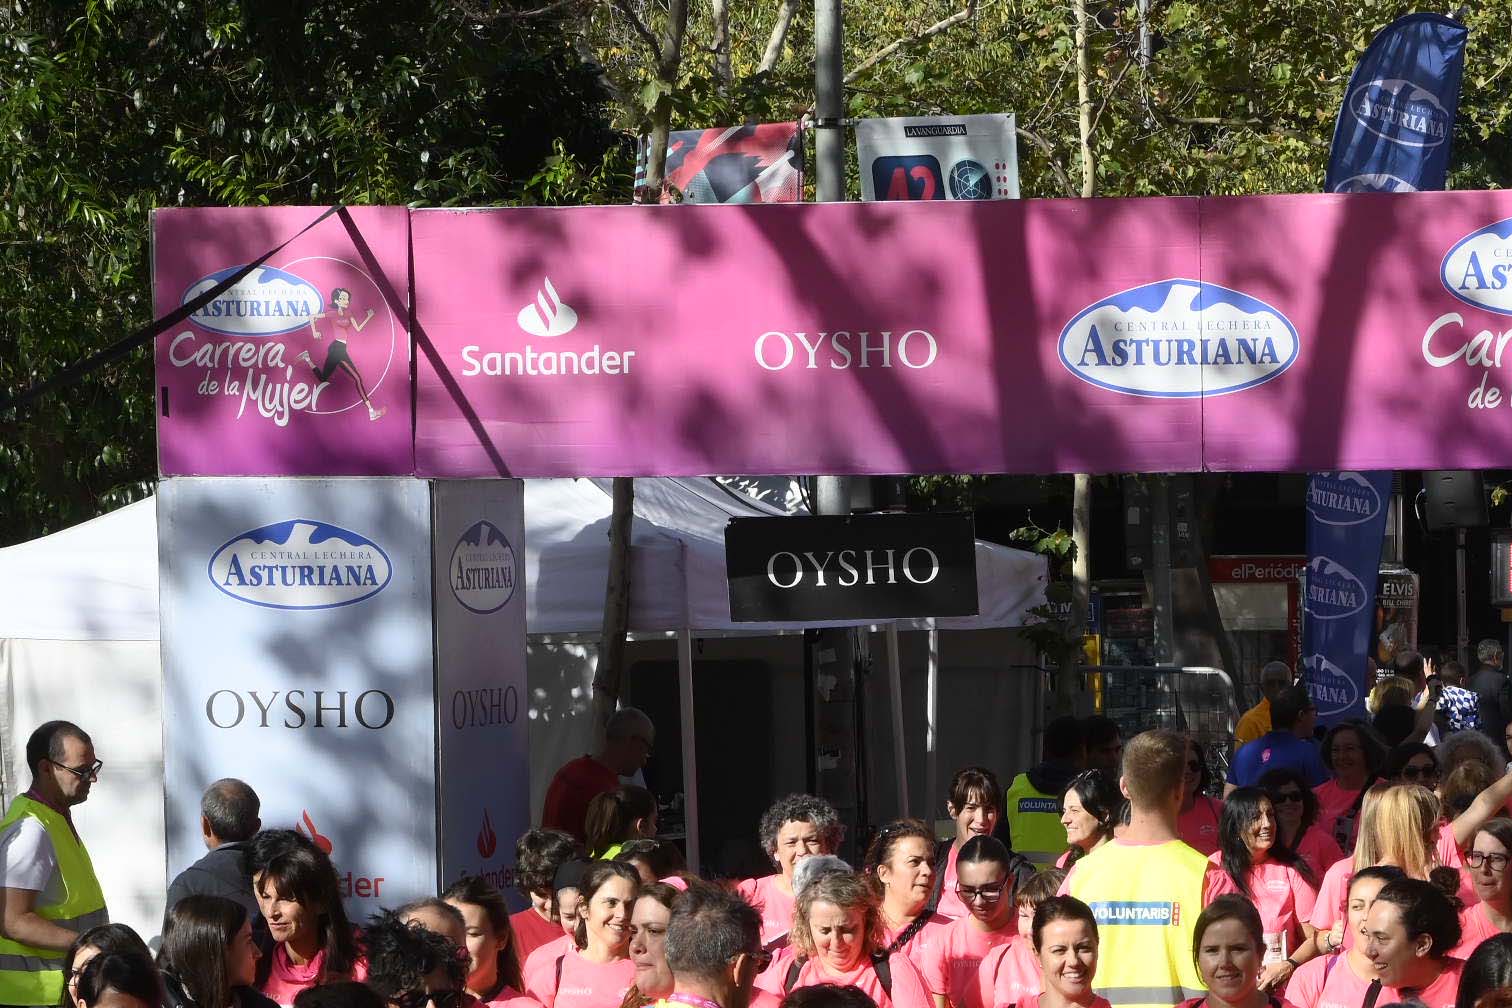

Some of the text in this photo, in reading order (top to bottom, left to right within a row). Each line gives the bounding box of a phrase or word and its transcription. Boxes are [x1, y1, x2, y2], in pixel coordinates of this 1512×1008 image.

[1114, 319, 1272, 332] CENTRAL LECHERA
[169, 331, 286, 368] Carrera
[461, 344, 636, 376] Santander
[753, 329, 938, 371] OYSHO
[1076, 323, 1280, 367] ASTURIANA
[198, 370, 240, 396] de la
[237, 365, 329, 427] Mujer
[1467, 370, 1503, 409] de
[223, 553, 379, 587] ASTURIANA
[250, 551, 373, 560] CENTRAL LECHERA
[767, 546, 940, 589] OYSHO
[455, 560, 513, 591] ASTURIANA
[1383, 582, 1414, 597] ELVIS
[205, 689, 396, 730] OYSHO
[451, 684, 518, 730] OYSHO
[1091, 906, 1171, 921] VOLUNTARIS
